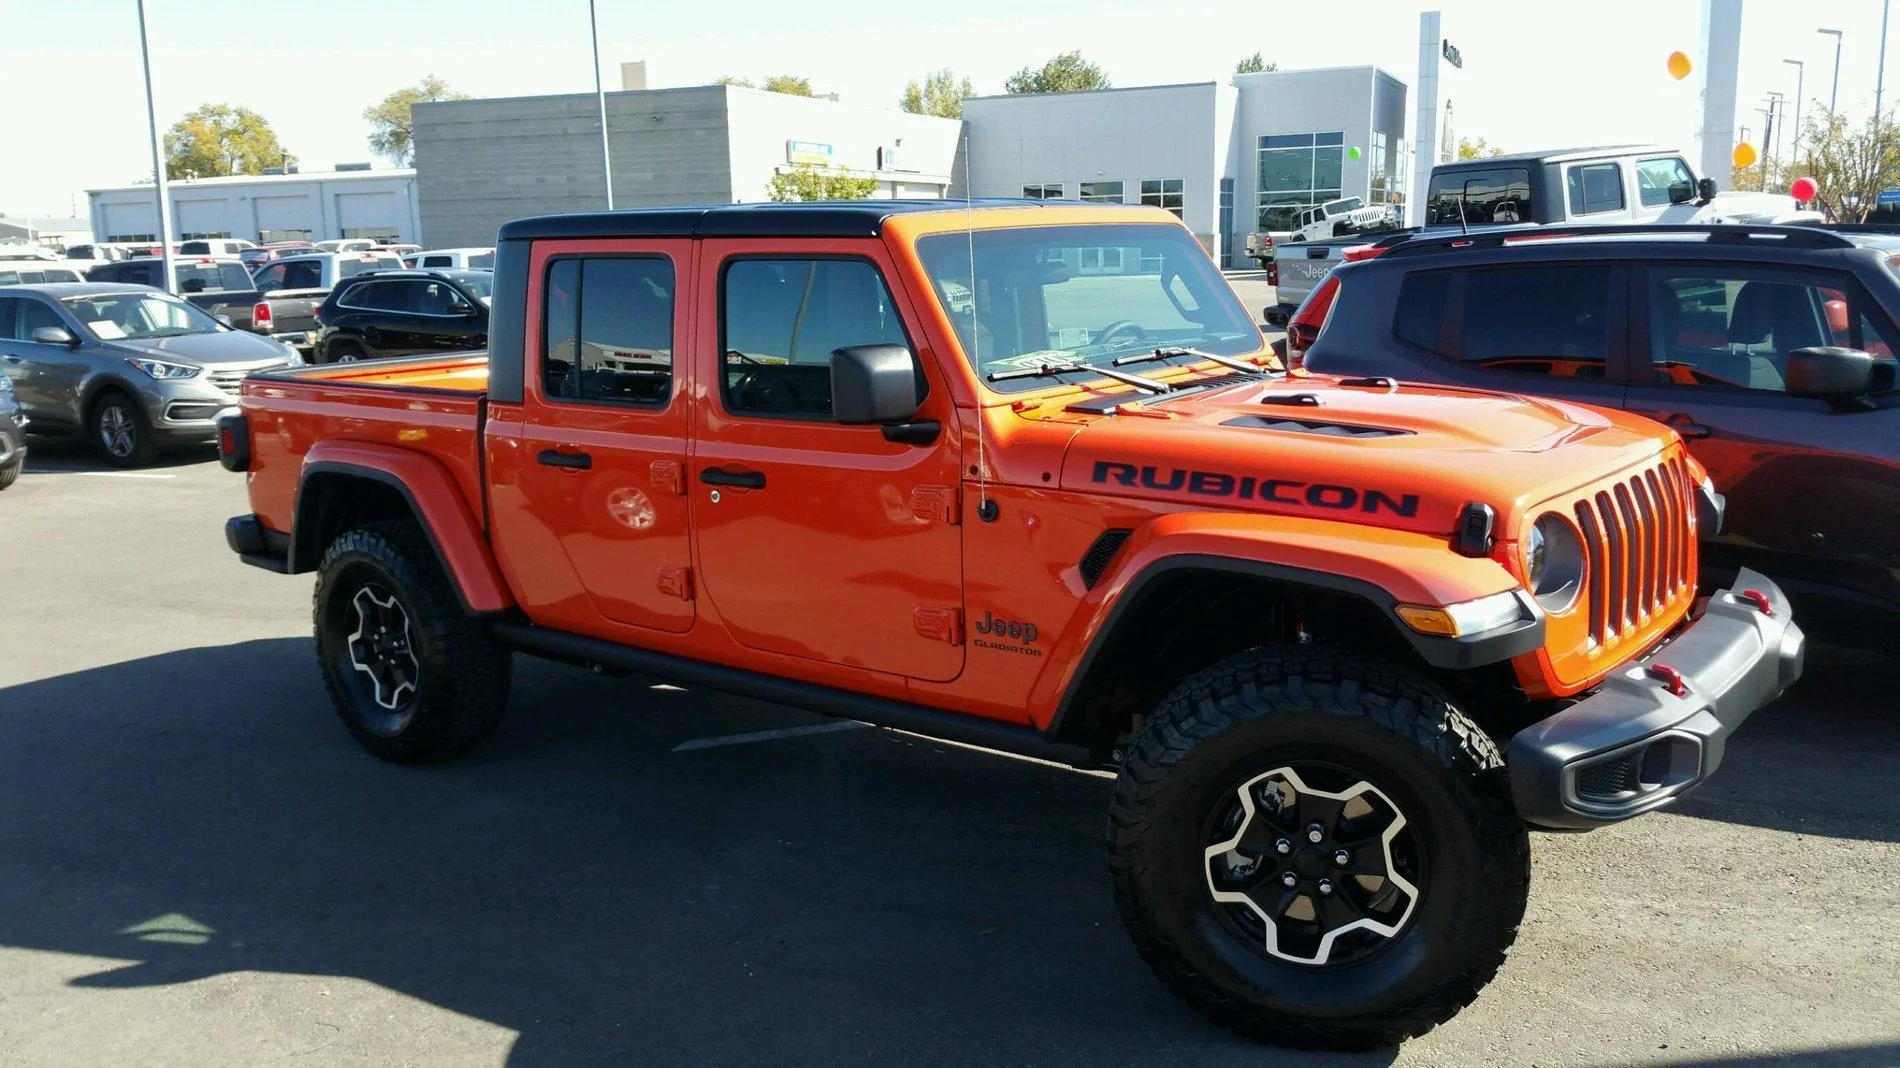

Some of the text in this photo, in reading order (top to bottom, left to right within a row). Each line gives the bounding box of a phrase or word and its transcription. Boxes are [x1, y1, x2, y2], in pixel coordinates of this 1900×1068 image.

[1091, 459, 1421, 518] RUBICON
[975, 609, 1039, 646] Jeep
[973, 638, 1043, 657] GLADIATOR
